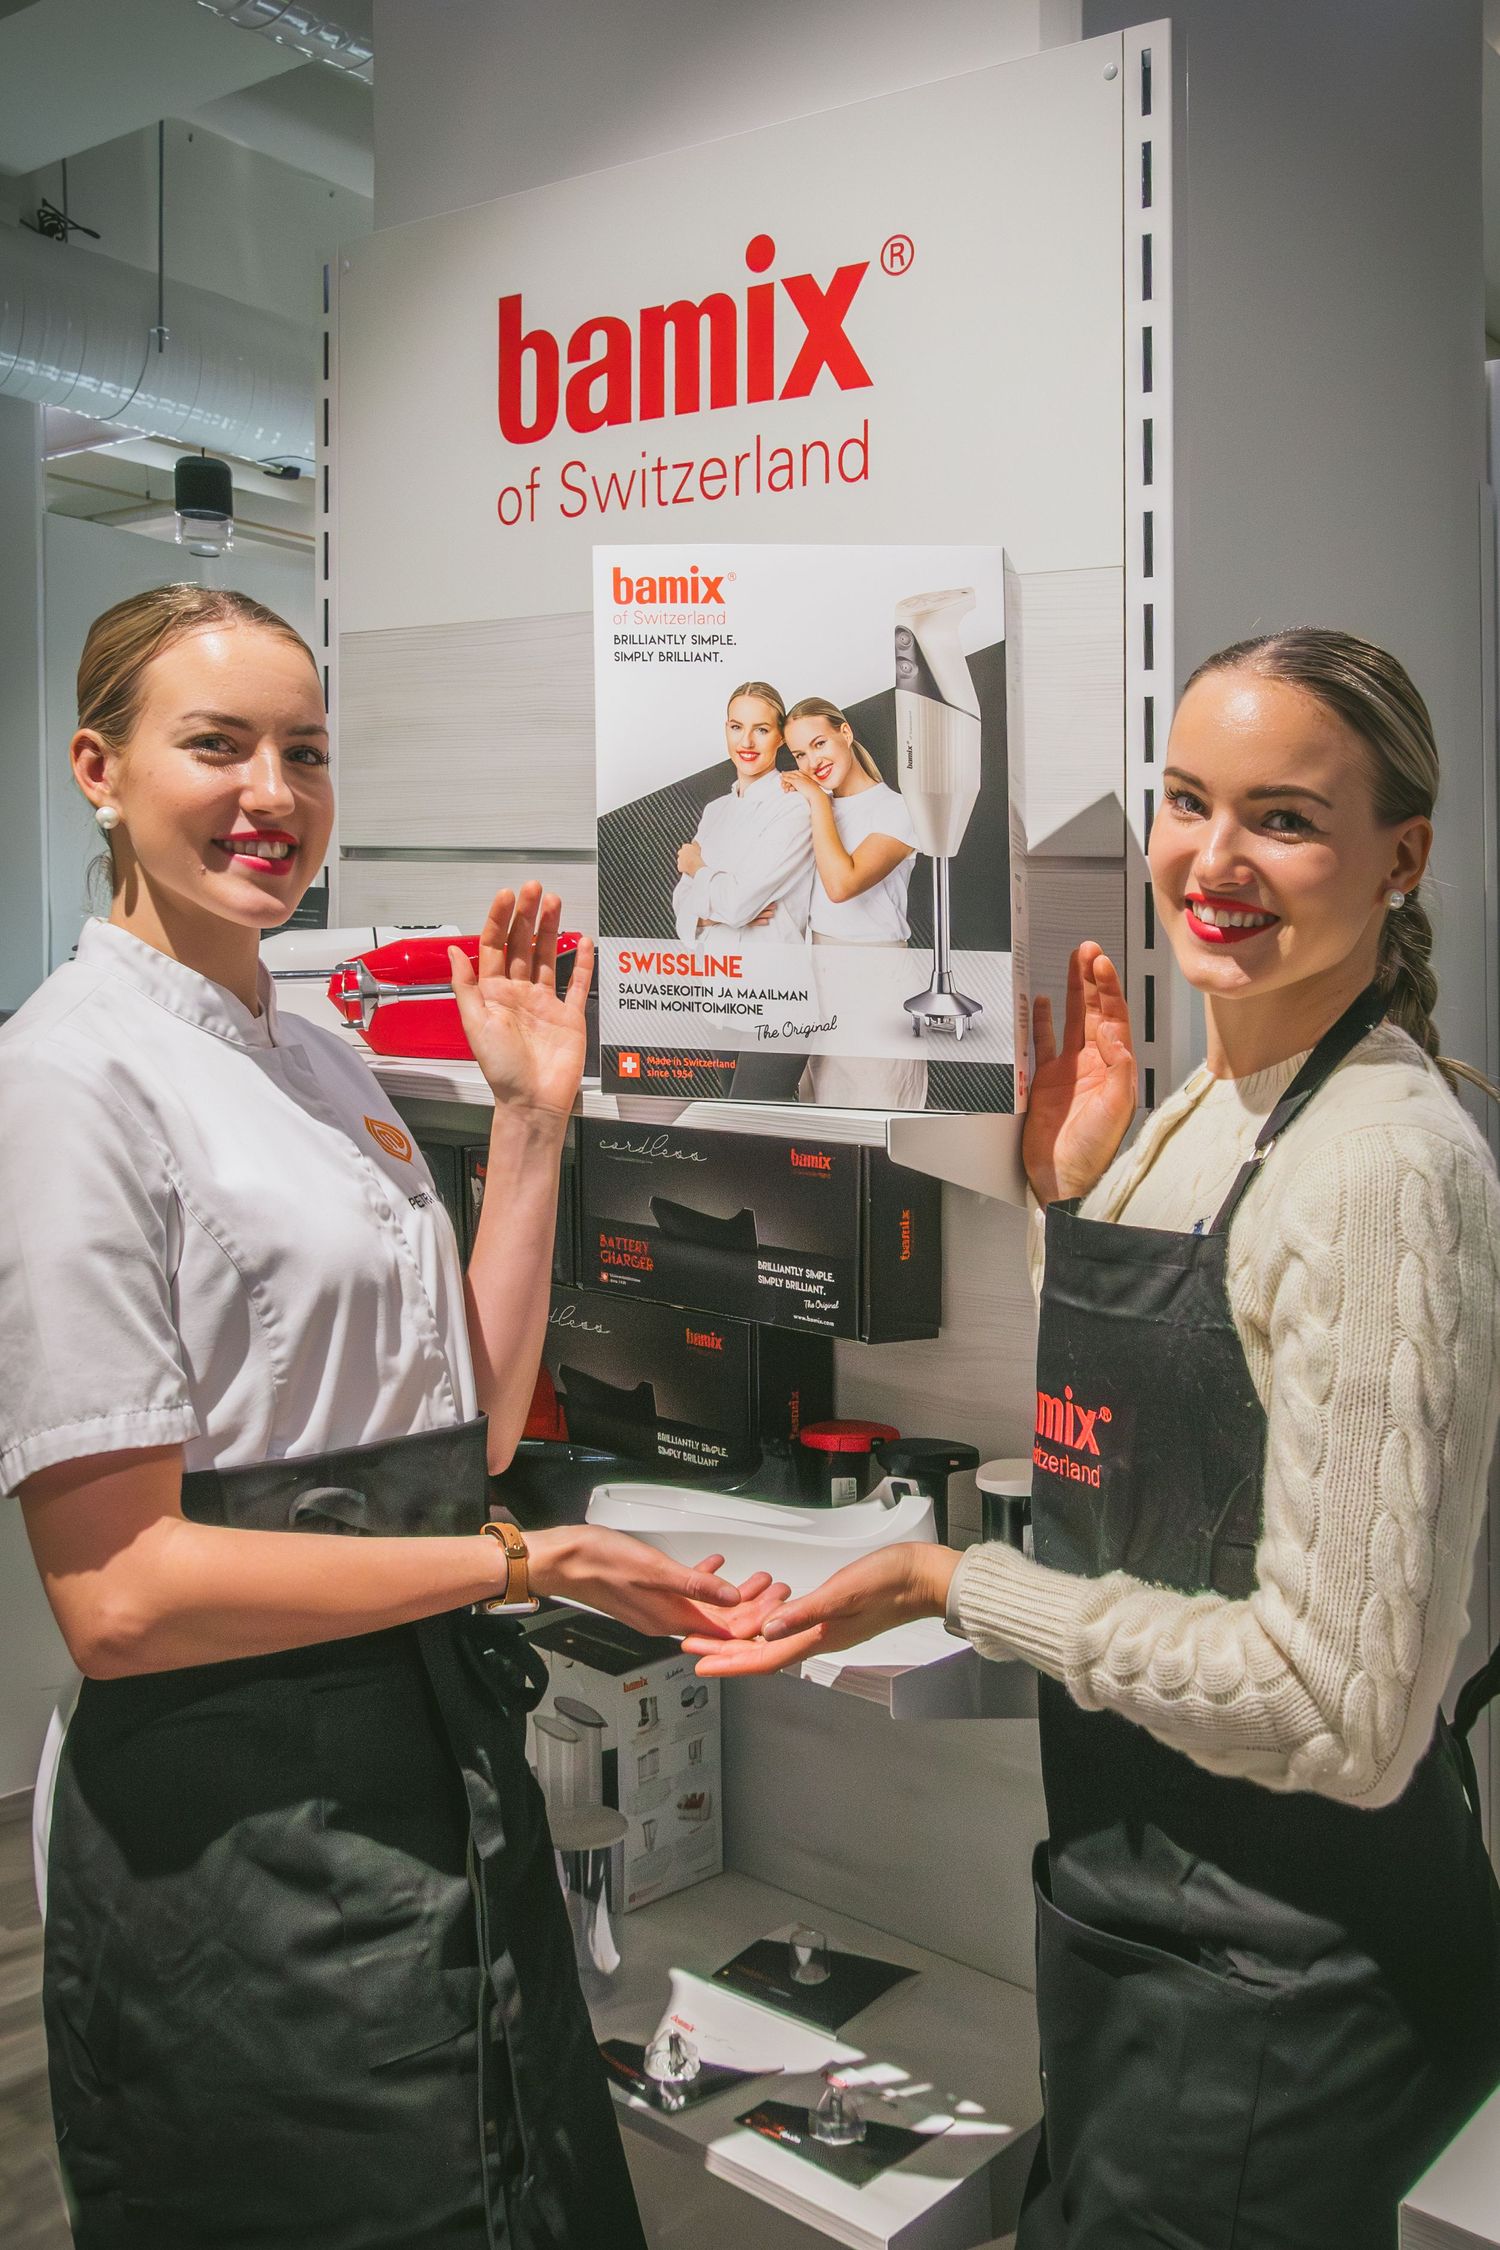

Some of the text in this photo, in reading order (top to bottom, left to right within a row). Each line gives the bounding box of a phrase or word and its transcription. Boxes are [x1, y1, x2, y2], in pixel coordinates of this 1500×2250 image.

[497, 419, 869, 525] of Switzerland
[612, 609, 726, 625] of Switzerland
[613, 634, 737, 646] BRILLIANTLY SIMPLE.
[614, 651, 723, 663] SIMPLY BRILLIANT.
[618, 951, 743, 978] SWISSLINE
[618, 983, 808, 1002] SAUVASEKOITIN JA MAAILMAN
[618, 998, 764, 1016] PIENIN MONITOIMIKONE
[754, 1014, 838, 1041] The Original
[646, 1056, 736, 1070] Made in Switzerland
[646, 1070, 694, 1079] since 1954
[600, 1134, 708, 1162] cordless
[790, 1148, 832, 1171] bamix
[899, 1208, 911, 1261] bamix
[600, 1234, 648, 1255] BATTERY
[600, 1250, 654, 1271] CHARGER
[757, 1260, 835, 1282] BRILLIANTLY SIMPLE.
[757, 1275, 826, 1296] SIMPLY BRILLIANT.
[804, 1300, 839, 1311] The Original
[793, 1314, 835, 1327] www.bamix.com
[657, 1432, 699, 1449] BRILLIANTLY
[657, 1446, 681, 1459] SIMPLY
